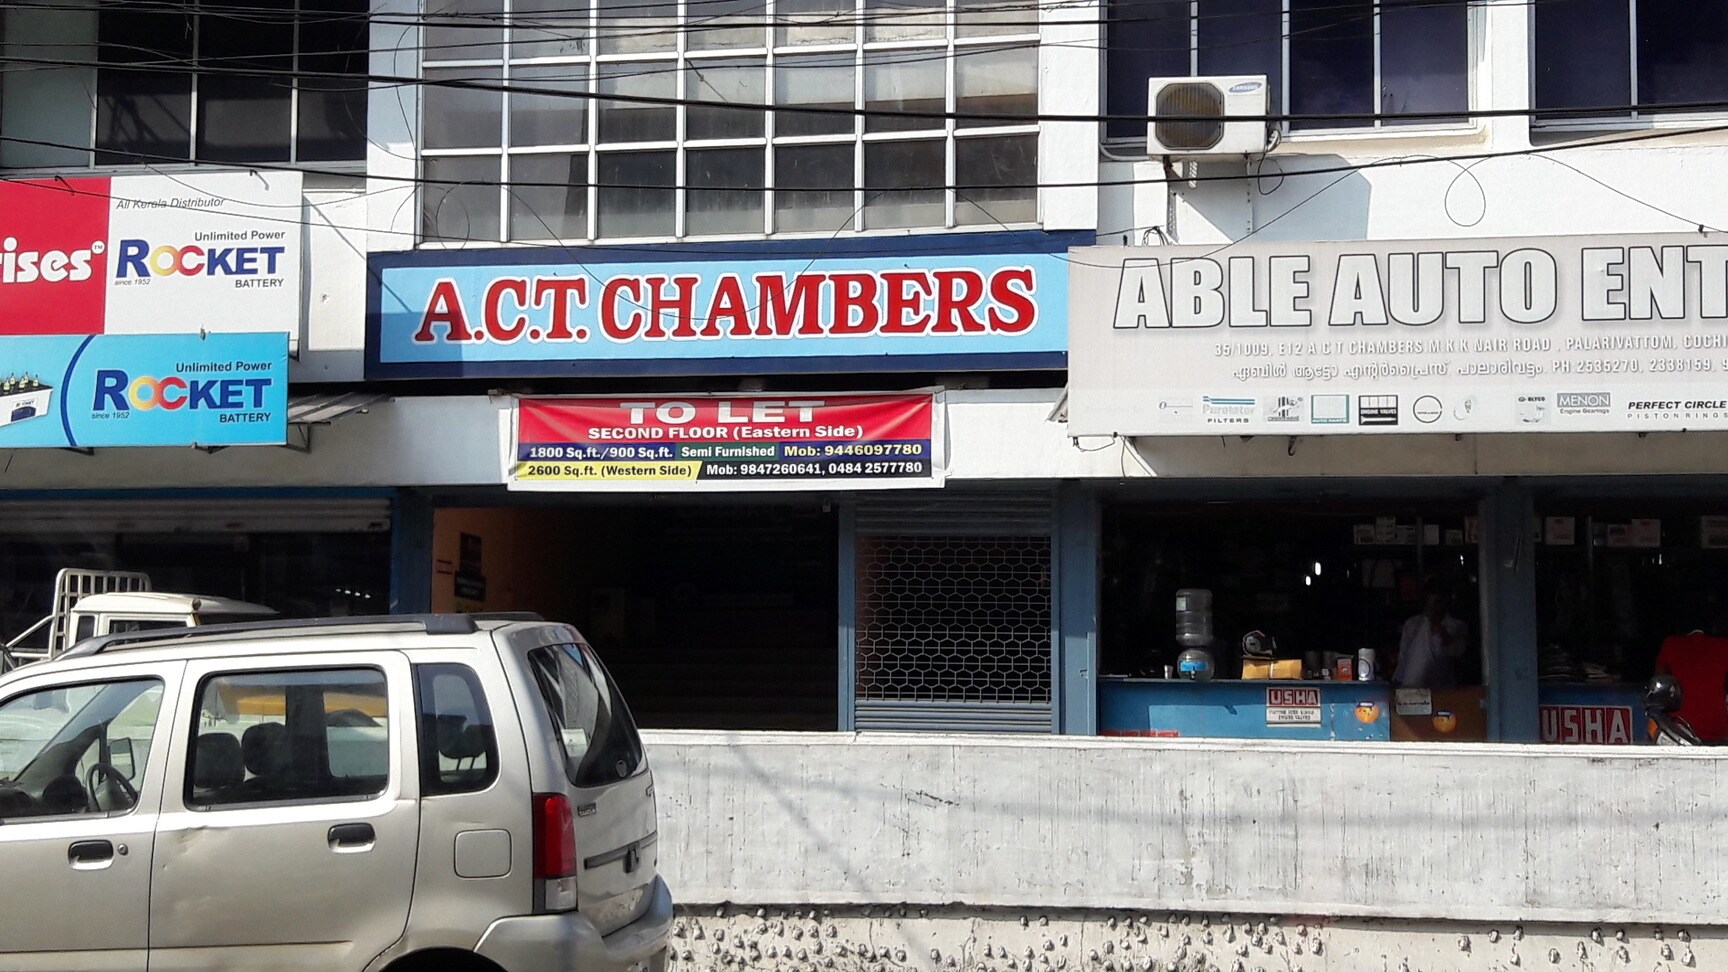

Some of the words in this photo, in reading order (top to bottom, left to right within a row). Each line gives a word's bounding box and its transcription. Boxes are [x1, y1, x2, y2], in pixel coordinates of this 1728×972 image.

[116, 200, 130, 209] All
[170, 197, 226, 208] Distributor
[195, 231, 248, 241] Unlimited
[251, 230, 286, 240] Power
[0, 237, 92, 283] ises
[116, 239, 285, 278] ROCKET
[235, 279, 284, 288] BATTERY
[1113, 254, 1312, 329] ABLE
[1328, 247, 1558, 326] AUTO
[413, 276, 589, 342] A.C.T.
[599, 266, 1039, 341] CHAMBERS
[176, 362, 232, 373] Unlimited
[236, 361, 272, 371] Power
[93, 369, 272, 410] ROCKET
[1559, 393, 1610, 406] MENON
[1628, 401, 1681, 410] PERFECT
[1684, 400, 1727, 409] CIRCLE
[219, 412, 271, 423] BATTERY
[620, 401, 696, 424] TO
[718, 400, 825, 423] LET
[588, 427, 664, 439] SECOND
[668, 427, 728, 439] FLOOR
[733, 426, 811, 440] (Eastern
[815, 425, 863, 439] Side)
[530, 447, 563, 458] 1800
[640, 446, 673, 459] Sq.ft.
[681, 446, 711, 457] Semi
[715, 445, 775, 457] Furnished
[784, 445, 820, 457] Mob:
[824, 444, 922, 455] 9446097780
[528, 465, 560, 475] 2600
[564, 465, 597, 478] Sq.ft.
[601, 465, 656, 477] (Western
[659, 464, 692, 477] Side)
[706, 463, 738, 475] Mob:
[740, 462, 826, 476] 9847260641,
[828, 462, 862, 474] 0484
[865, 461, 923, 474] 2577780
[1270, 690, 1317, 705] USHA
[1543, 709, 1629, 743] USHA
